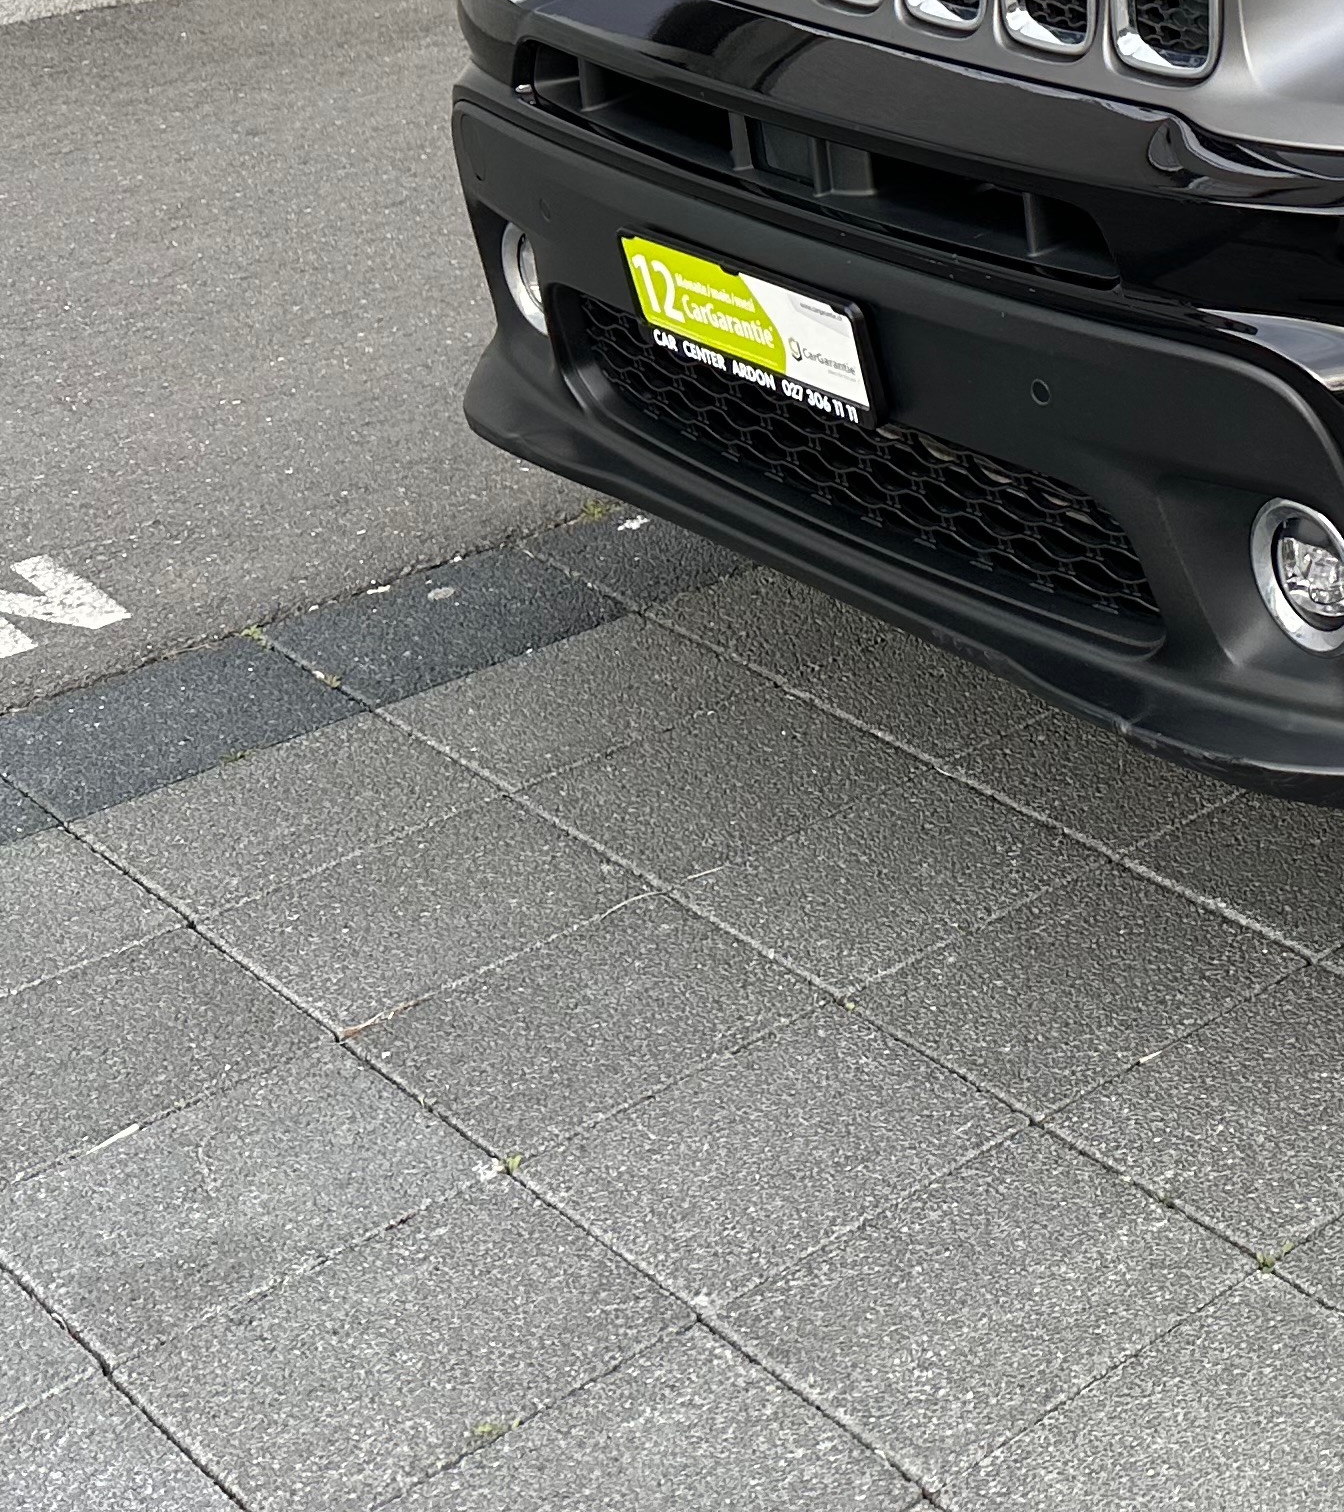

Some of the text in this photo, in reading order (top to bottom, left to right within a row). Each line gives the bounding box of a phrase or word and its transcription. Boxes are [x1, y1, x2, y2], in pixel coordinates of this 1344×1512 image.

[631, 253, 686, 324] 12
[653, 328, 679, 353] CAR
[682, 340, 728, 372] CENTER
[732, 359, 777, 392] ARDON
[781, 378, 804, 402] 027
[805, 389, 832, 414] 306
